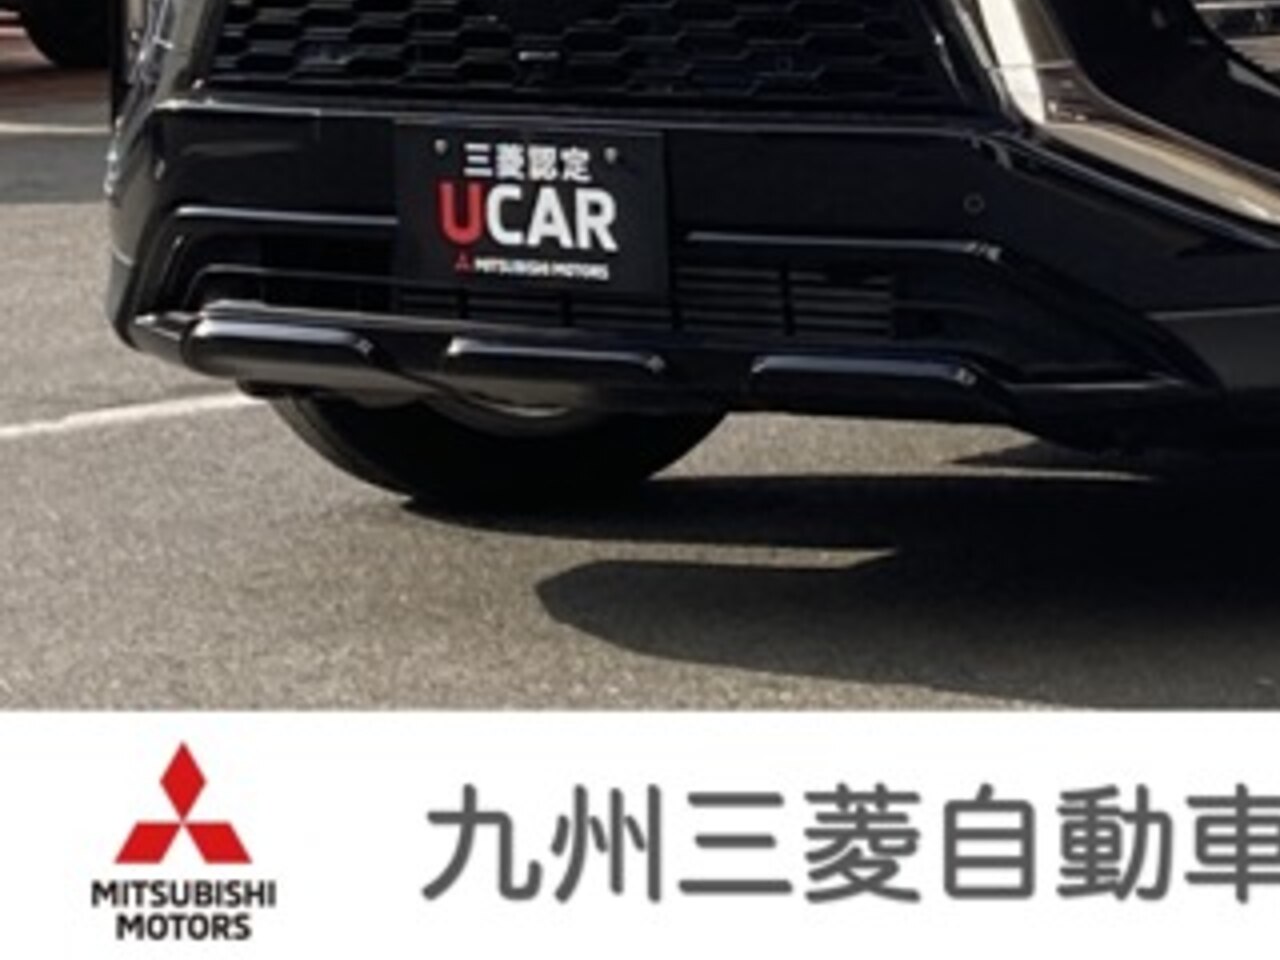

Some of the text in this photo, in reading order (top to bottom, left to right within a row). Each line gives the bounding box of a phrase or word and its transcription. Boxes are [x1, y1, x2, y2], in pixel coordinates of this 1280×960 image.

[462, 141, 592, 182] 三菱認定
[438, 181, 619, 252] UCAR
